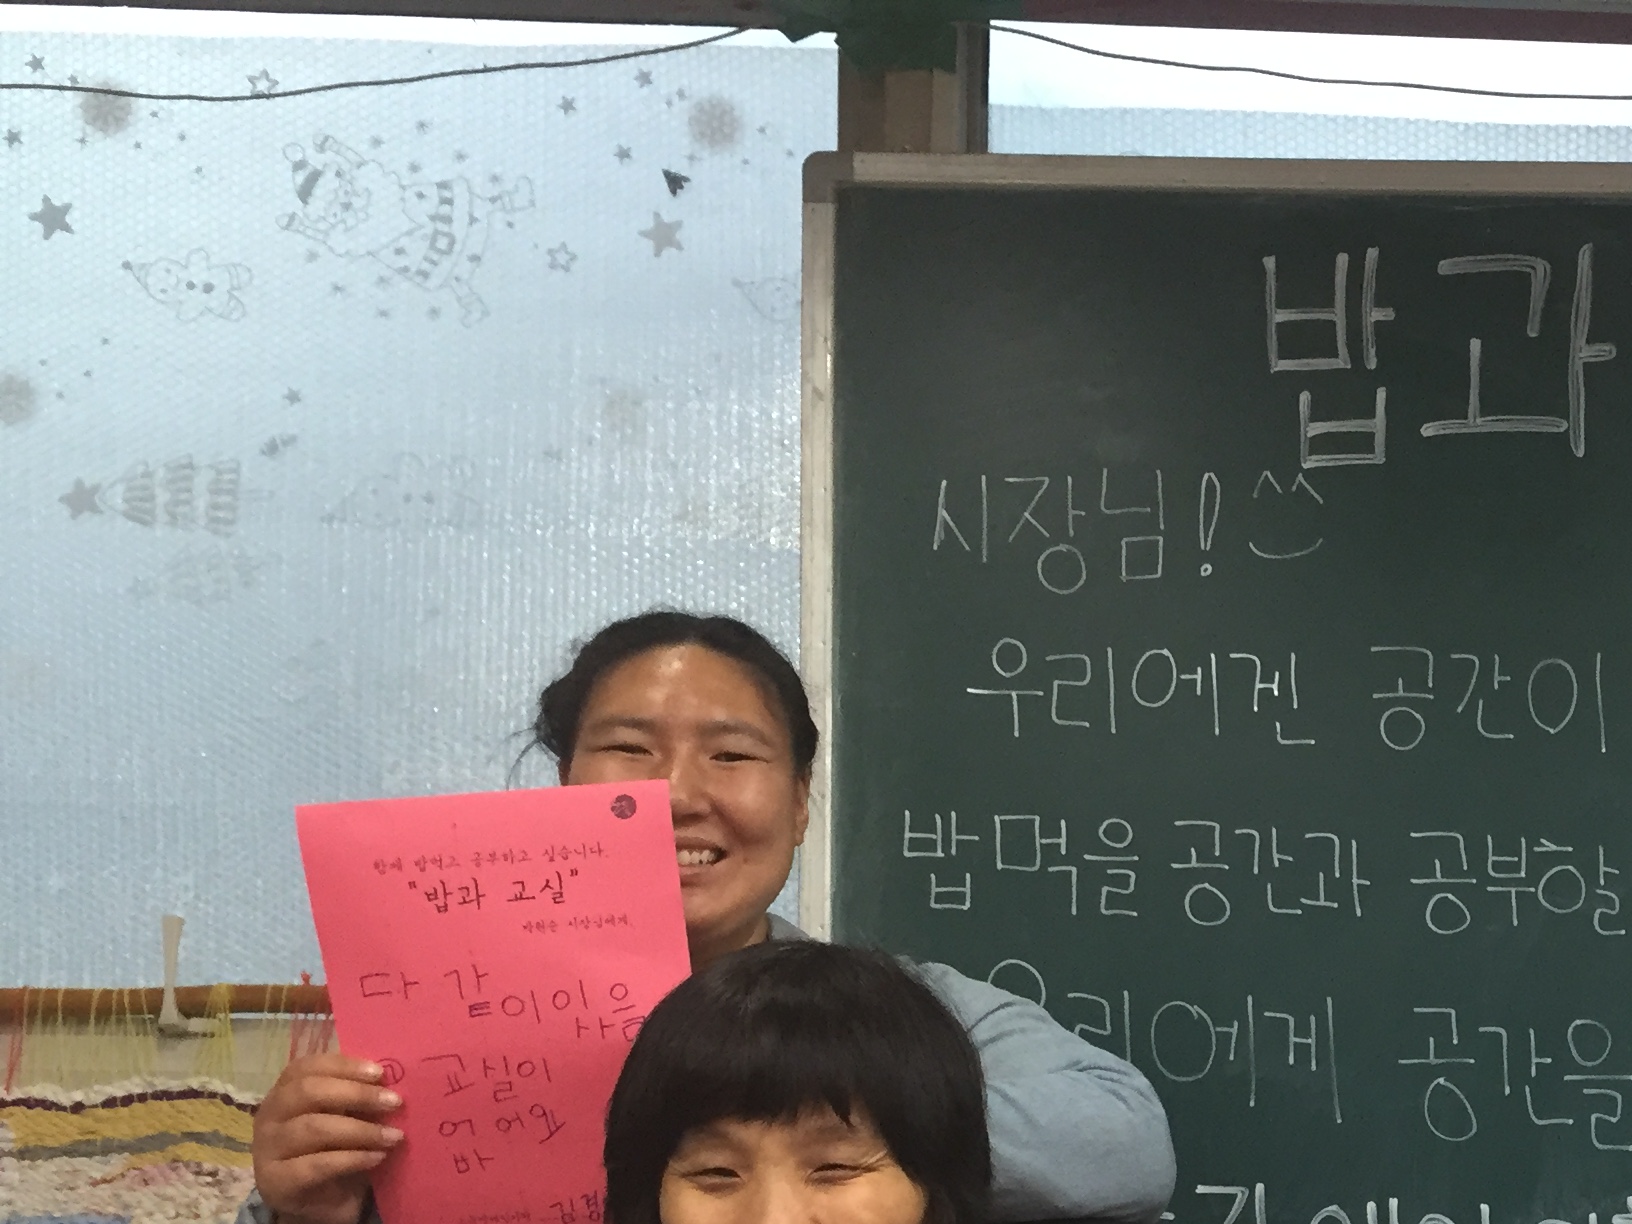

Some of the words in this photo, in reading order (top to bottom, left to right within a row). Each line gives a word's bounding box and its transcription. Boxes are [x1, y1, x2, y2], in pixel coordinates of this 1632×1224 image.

[1262, 242, 1617, 468] 밥과
[932, 468, 1222, 594] 시장님!
[966, 637, 1316, 747] 우리에겐
[1371, 643, 1607, 753] 공간이
[470, 847, 533, 869] 공부하고
[1170, 819, 1371, 926] 공간과
[1410, 830, 1626, 936] 공부할
[359, 971, 420, 1000] 다
[420, 1053, 552, 1104] 교실이
